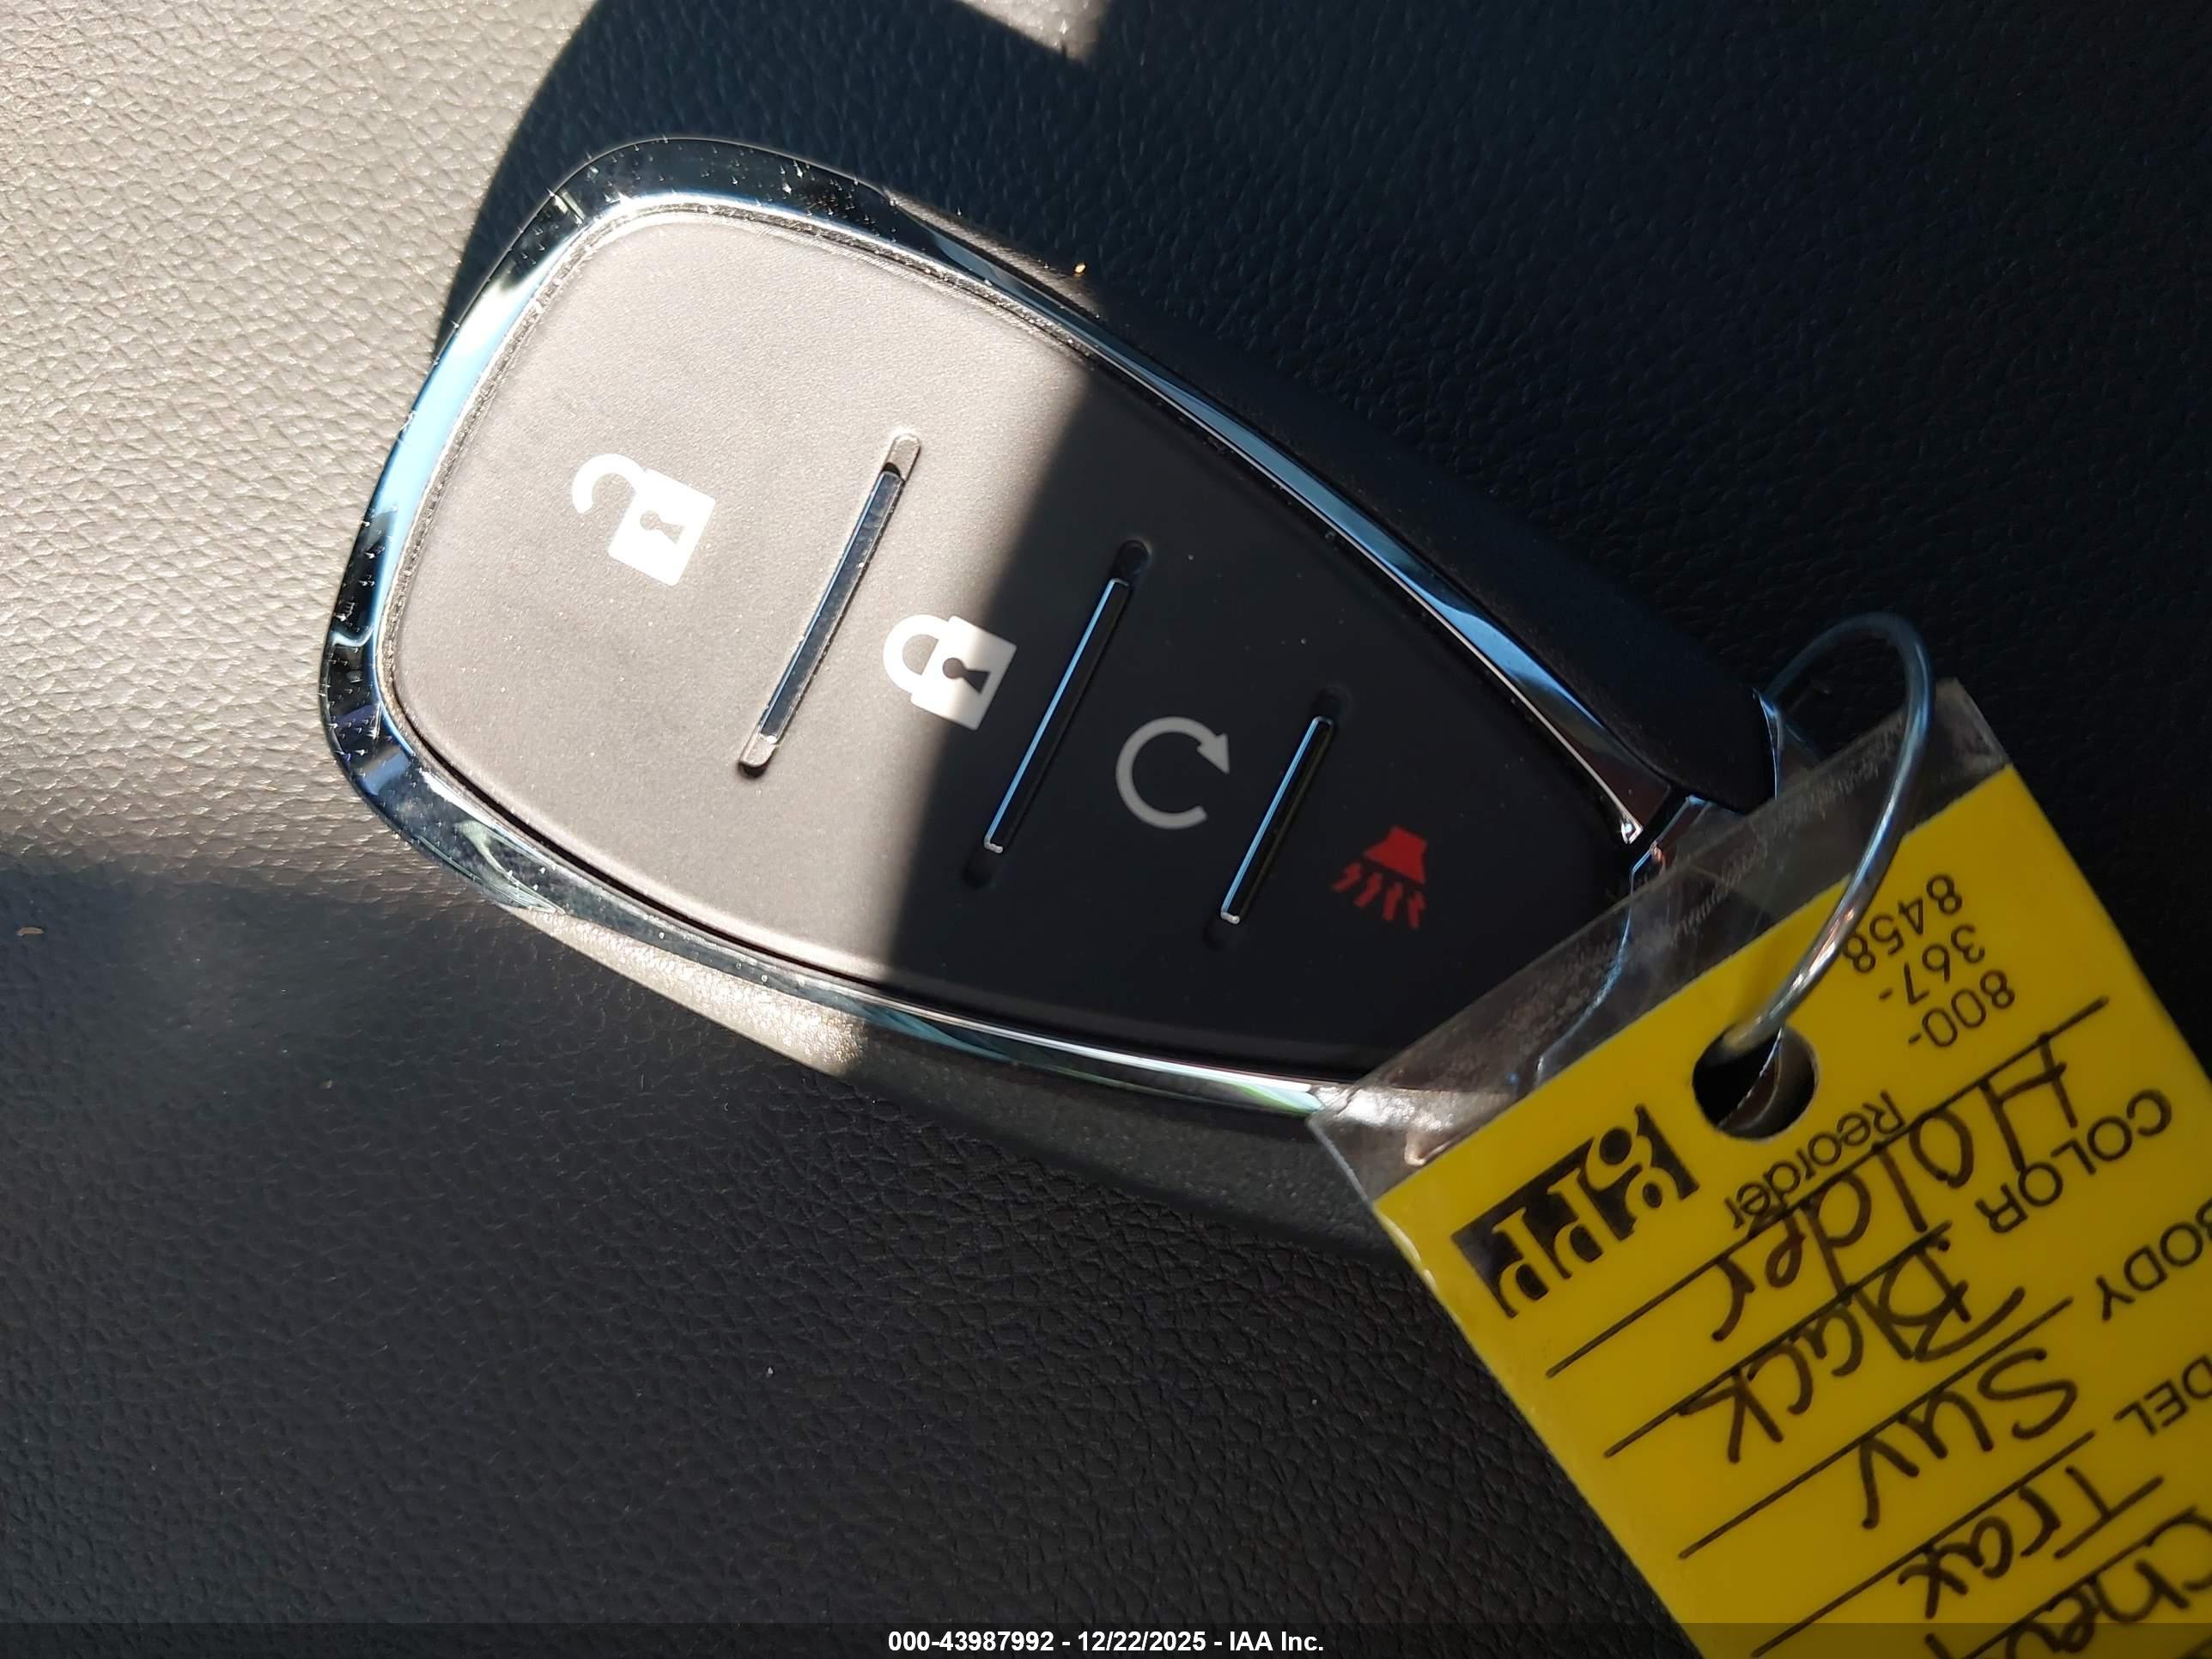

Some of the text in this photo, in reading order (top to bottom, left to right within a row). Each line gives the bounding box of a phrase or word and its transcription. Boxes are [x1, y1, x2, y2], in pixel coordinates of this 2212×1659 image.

[1843, 874, 1963, 973] 8458
[1879, 924, 1985, 1005] 367-
[1908, 969, 2015, 1048] 800-
[1711, 1033, 2079, 1342] Holder
[1724, 1090, 1905, 1229] Reorder
[1974, 1089, 2172, 1233] COLOR
[1677, 1237, 2025, 1463] Black
[1897, 1465, 2164, 1620] Trax
[1924, 1510, 2212, 1659] Chev
